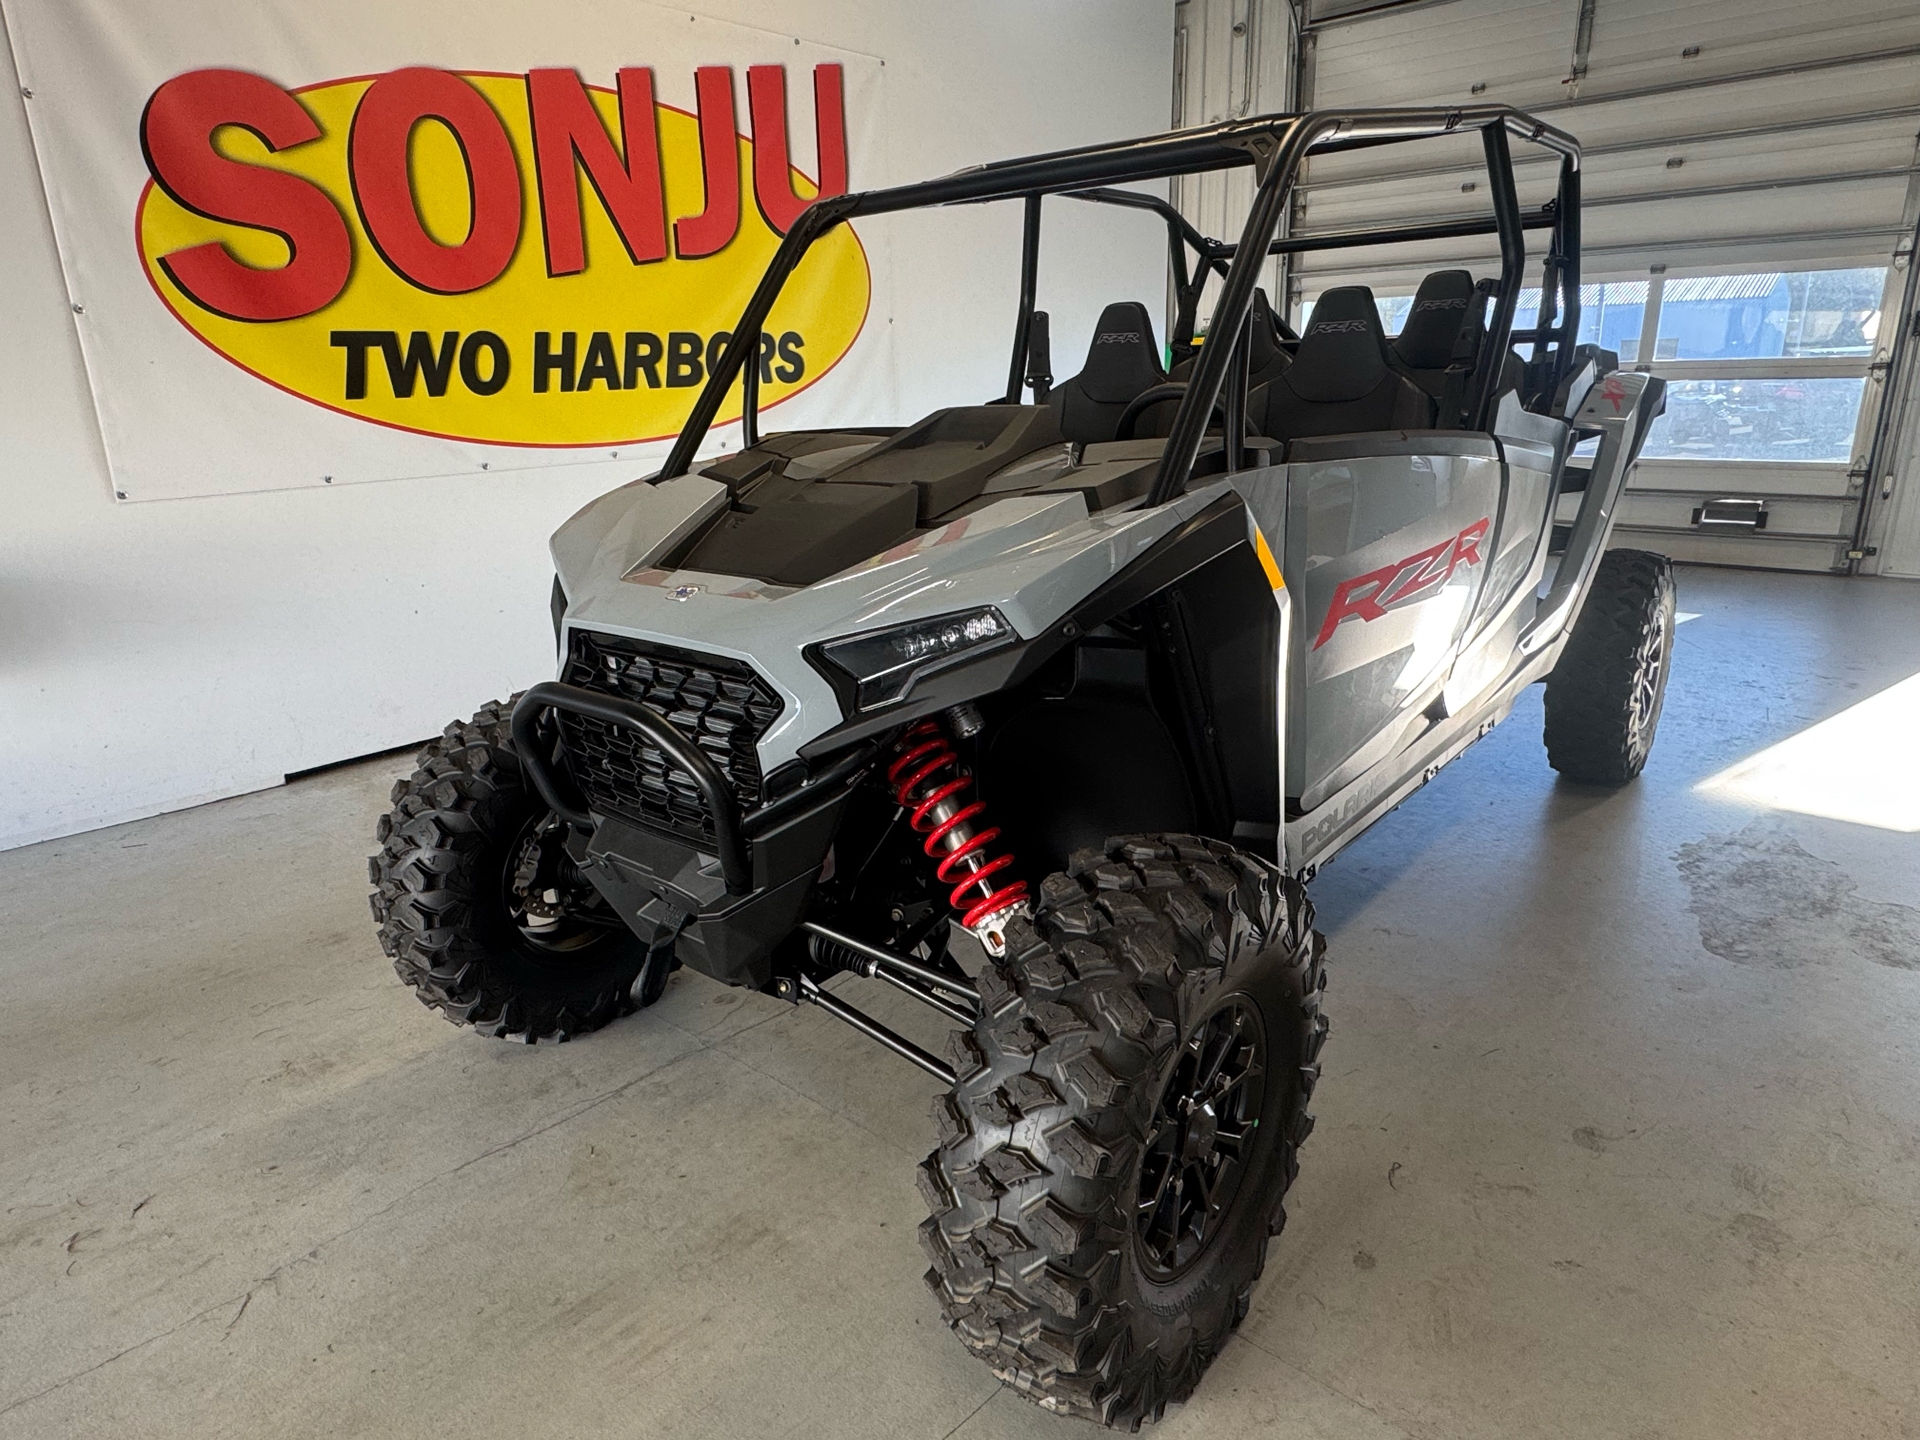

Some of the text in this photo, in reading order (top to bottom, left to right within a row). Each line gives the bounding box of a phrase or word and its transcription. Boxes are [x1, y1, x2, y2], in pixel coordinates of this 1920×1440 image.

[140, 65, 848, 322] SONJU
[1097, 332, 1140, 345] RZR
[1310, 320, 1367, 335] RZR
[1416, 298, 1466, 312] RZR
[330, 331, 510, 400] TWO
[1312, 516, 1490, 652] RZR
[1301, 773, 1388, 856] POLARIS
